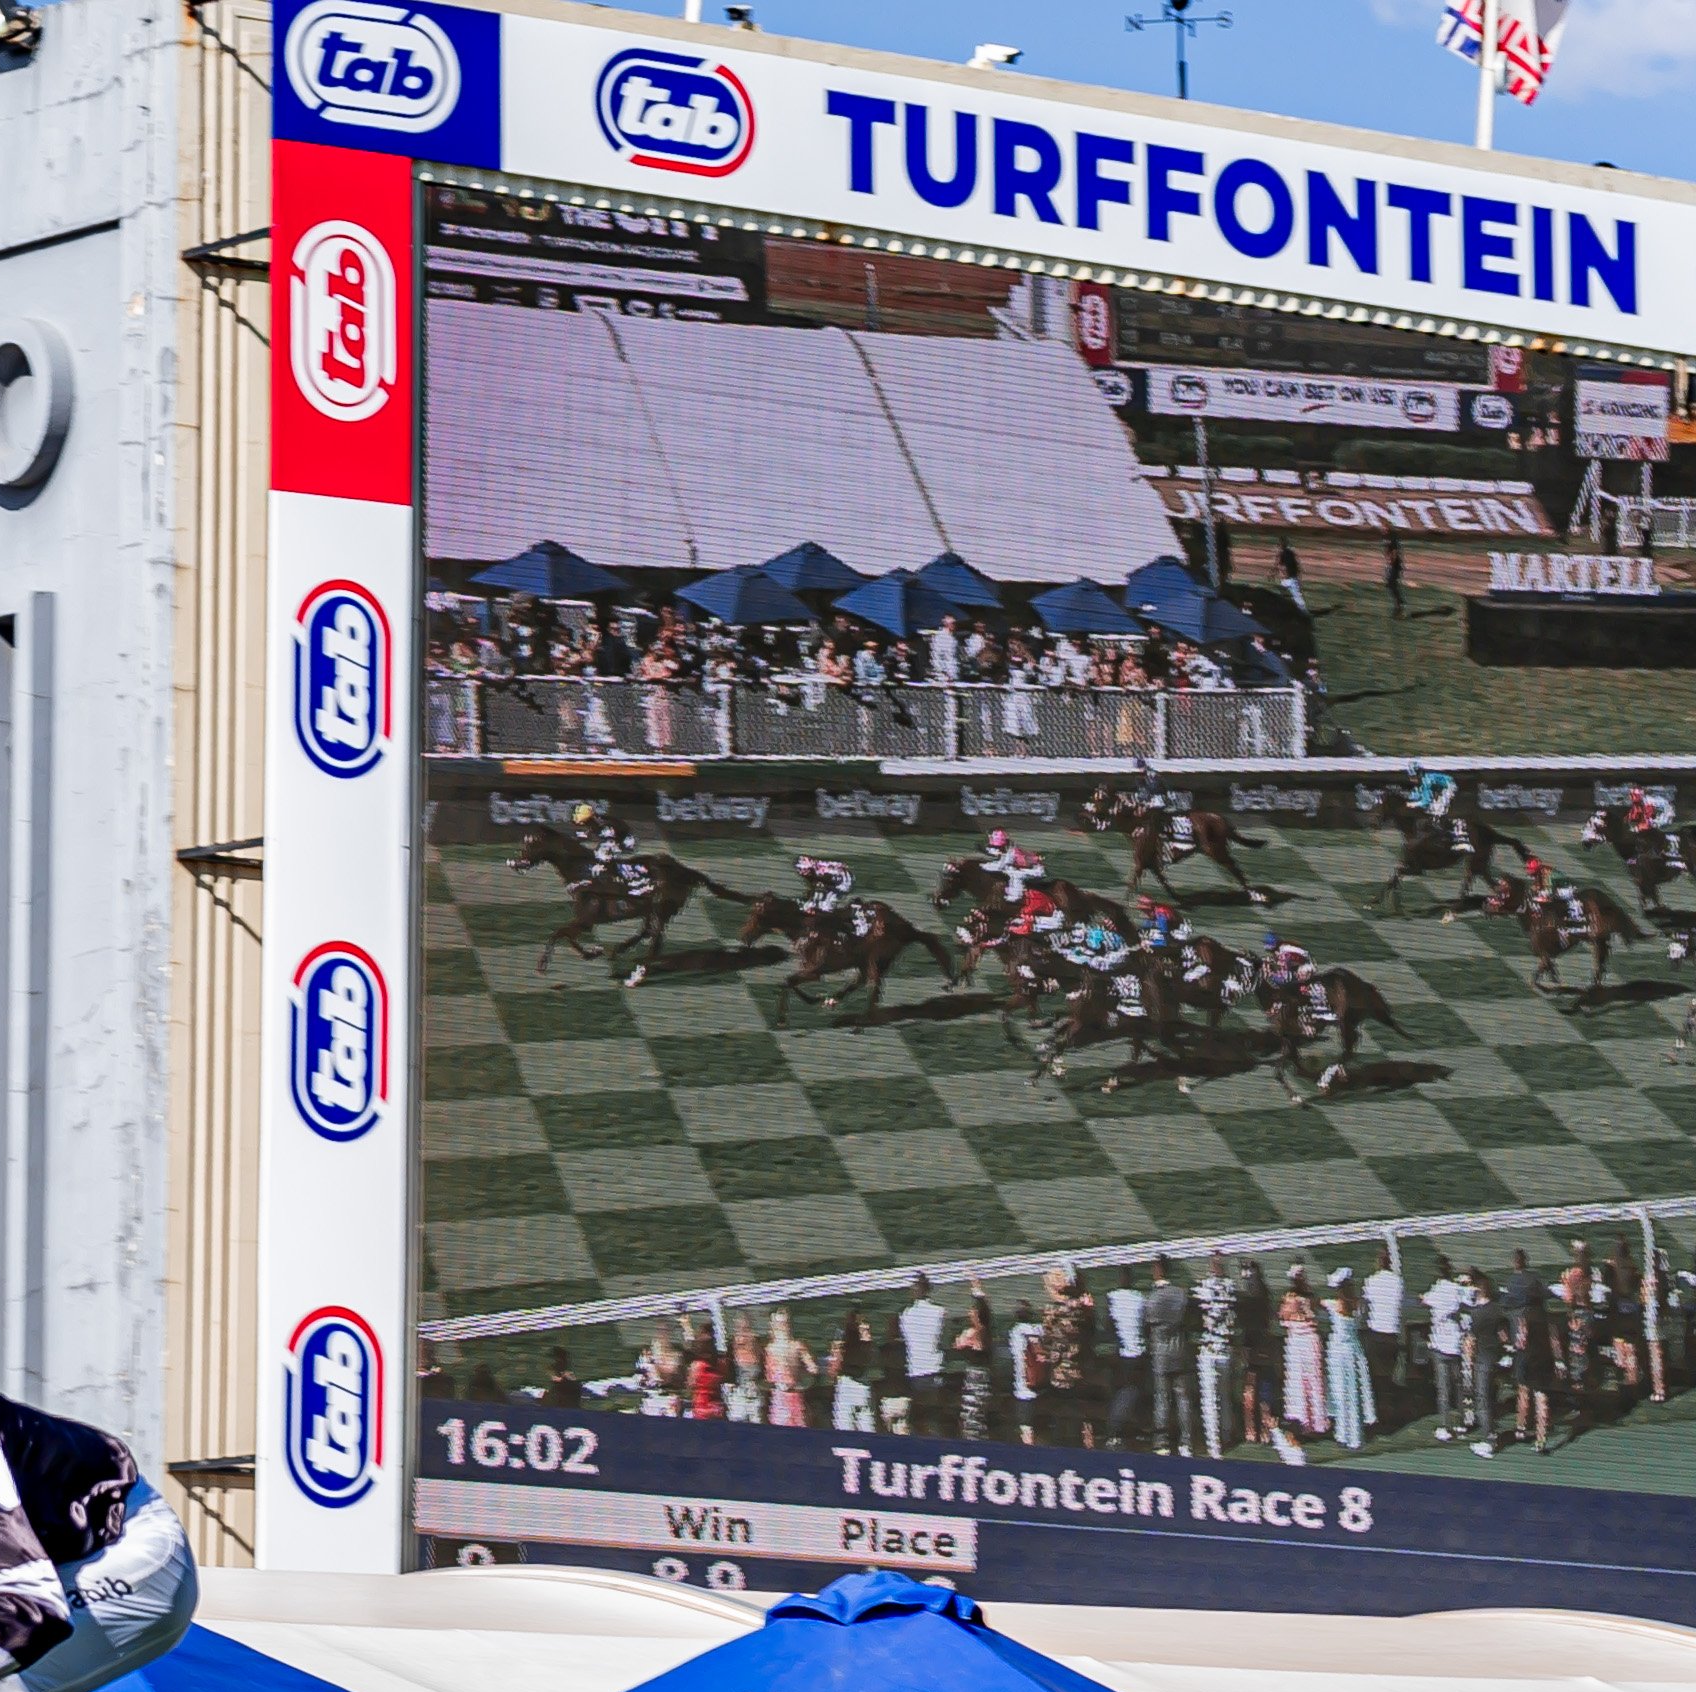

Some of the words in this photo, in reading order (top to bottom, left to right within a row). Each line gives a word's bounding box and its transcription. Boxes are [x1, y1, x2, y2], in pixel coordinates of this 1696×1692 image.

[318, 28, 436, 101] tab
[616, 74, 741, 150] tab
[826, 90, 1638, 315] TURFFONTEIN
[321, 247, 370, 390] tab
[1163, 488, 1543, 535] URFFONTEIN
[1486, 550, 1662, 597] MARTELL
[316, 604, 375, 750] tab
[312, 966, 371, 1113] tab
[307, 1331, 366, 1475] tab
[438, 1417, 600, 1477] 16:02
[834, 1447, 1174, 1520] Turffontein
[1189, 1475, 1326, 1530] Race
[1336, 1487, 1375, 1534] 8
[663, 1504, 754, 1545] Win
[839, 1517, 958, 1559] Place
